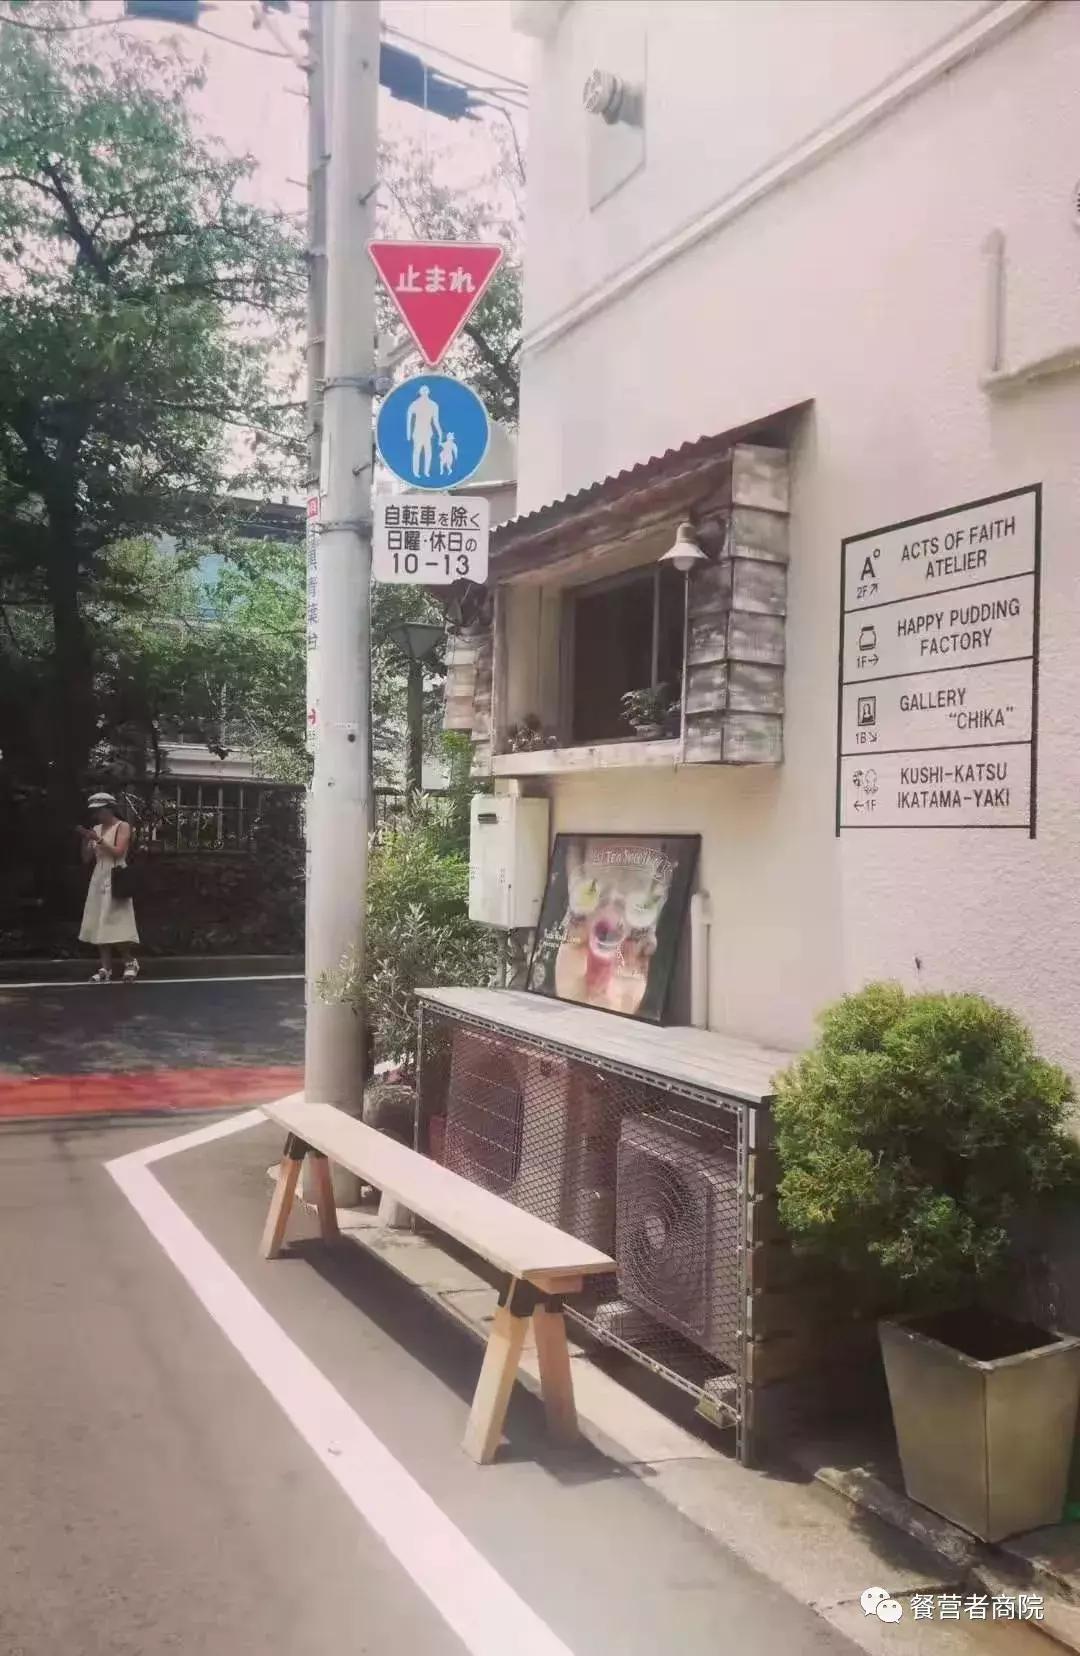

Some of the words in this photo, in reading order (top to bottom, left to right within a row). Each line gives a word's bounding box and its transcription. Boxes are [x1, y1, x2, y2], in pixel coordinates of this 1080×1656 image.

[395, 264, 476, 293] 止まれ
[384, 504, 480, 528] 自転車を除く
[901, 536, 939, 561] ACTS
[944, 530, 965, 550] OF
[969, 515, 1016, 545] FAITH
[926, 548, 988, 578] ATELIER
[897, 611, 944, 637] HAPPY
[949, 598, 1020, 627] PUDDING
[920, 627, 992, 656] FACTORY
[900, 688, 966, 711] GALLERY
[900, 762, 1008, 785] KUSHI-KATSU
[898, 788, 1010, 809] IKATAMA-YAKI
